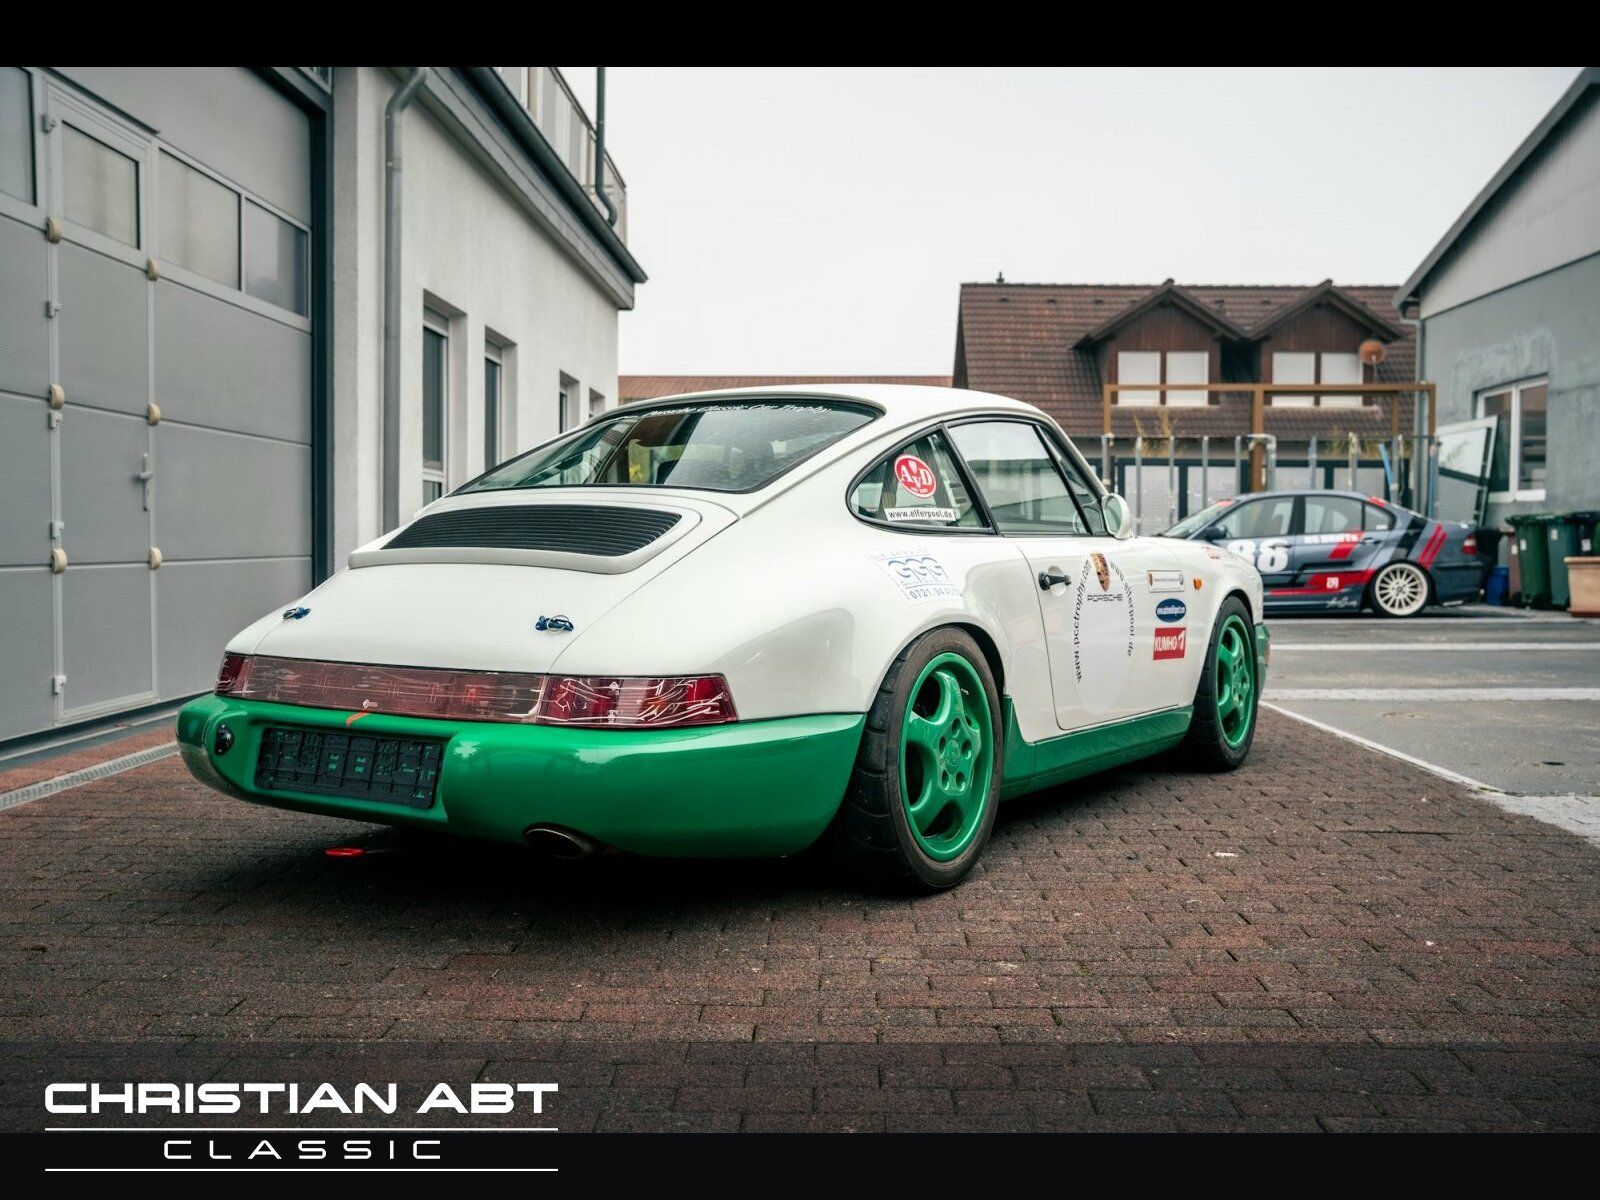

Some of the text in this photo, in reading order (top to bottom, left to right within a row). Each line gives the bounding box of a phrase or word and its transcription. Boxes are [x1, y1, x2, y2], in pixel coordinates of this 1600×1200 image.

[888, 508, 953, 519] www.elferpool.de
[1087, 594, 1123, 602] PORSCHE
[1154, 636, 1177, 651] KUMHO
